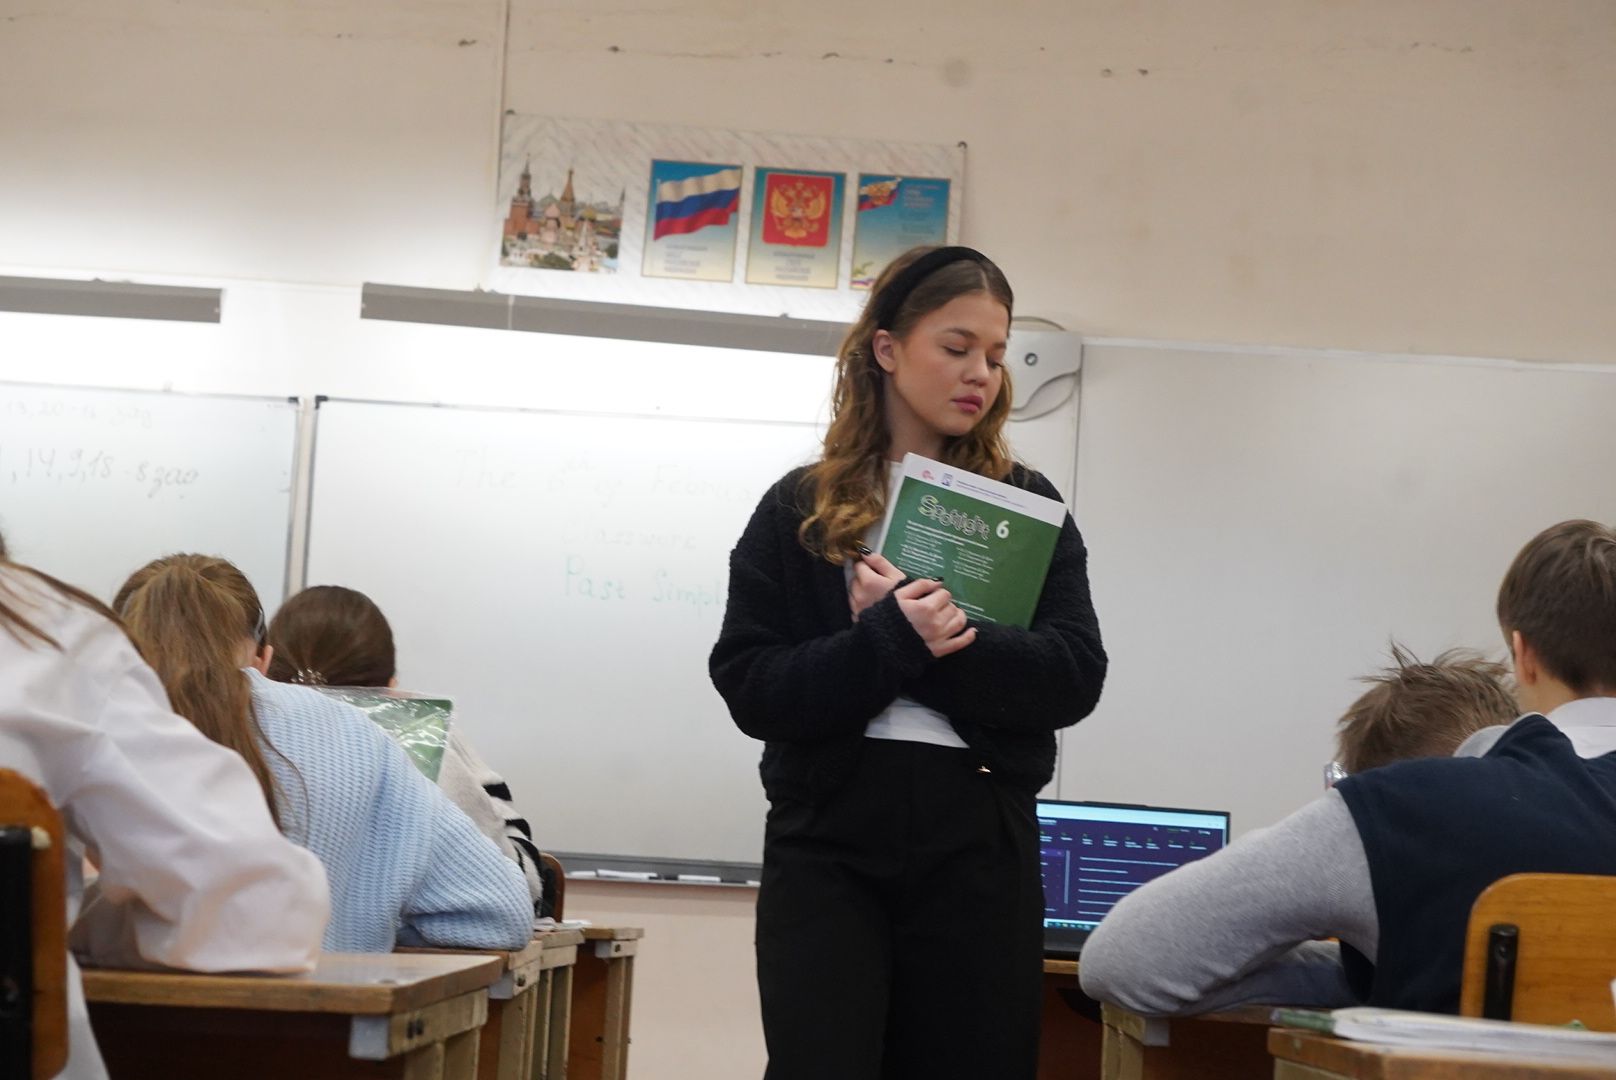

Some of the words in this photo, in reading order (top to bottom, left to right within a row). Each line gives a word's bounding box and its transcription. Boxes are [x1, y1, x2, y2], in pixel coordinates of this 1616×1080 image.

[455, 447, 518, 489] The
[918, 494, 991, 541] Spotlight
[995, 520, 1010, 539] 6
[563, 553, 626, 600] Past
[652, 567, 723, 618] Simpl
